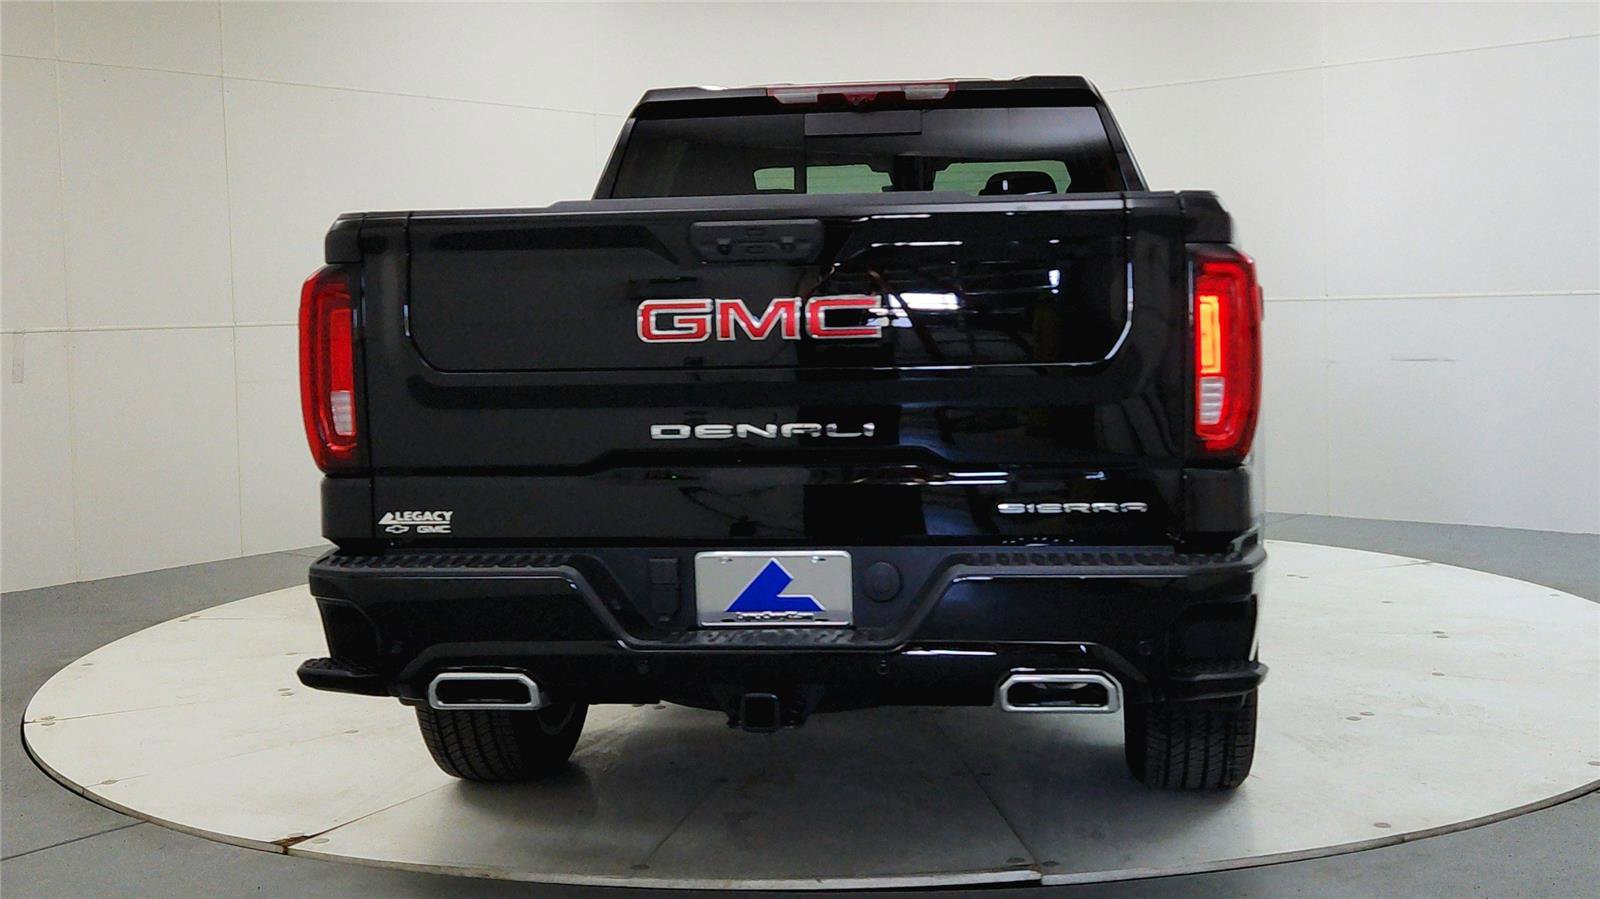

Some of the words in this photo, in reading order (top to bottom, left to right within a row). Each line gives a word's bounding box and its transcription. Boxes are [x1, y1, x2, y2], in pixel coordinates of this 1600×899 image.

[637, 295, 882, 342] GMC
[650, 423, 875, 439] DENALI
[997, 502, 1148, 514] SIERRA
[394, 511, 453, 521] LEGACY
[416, 525, 452, 533] GMC
